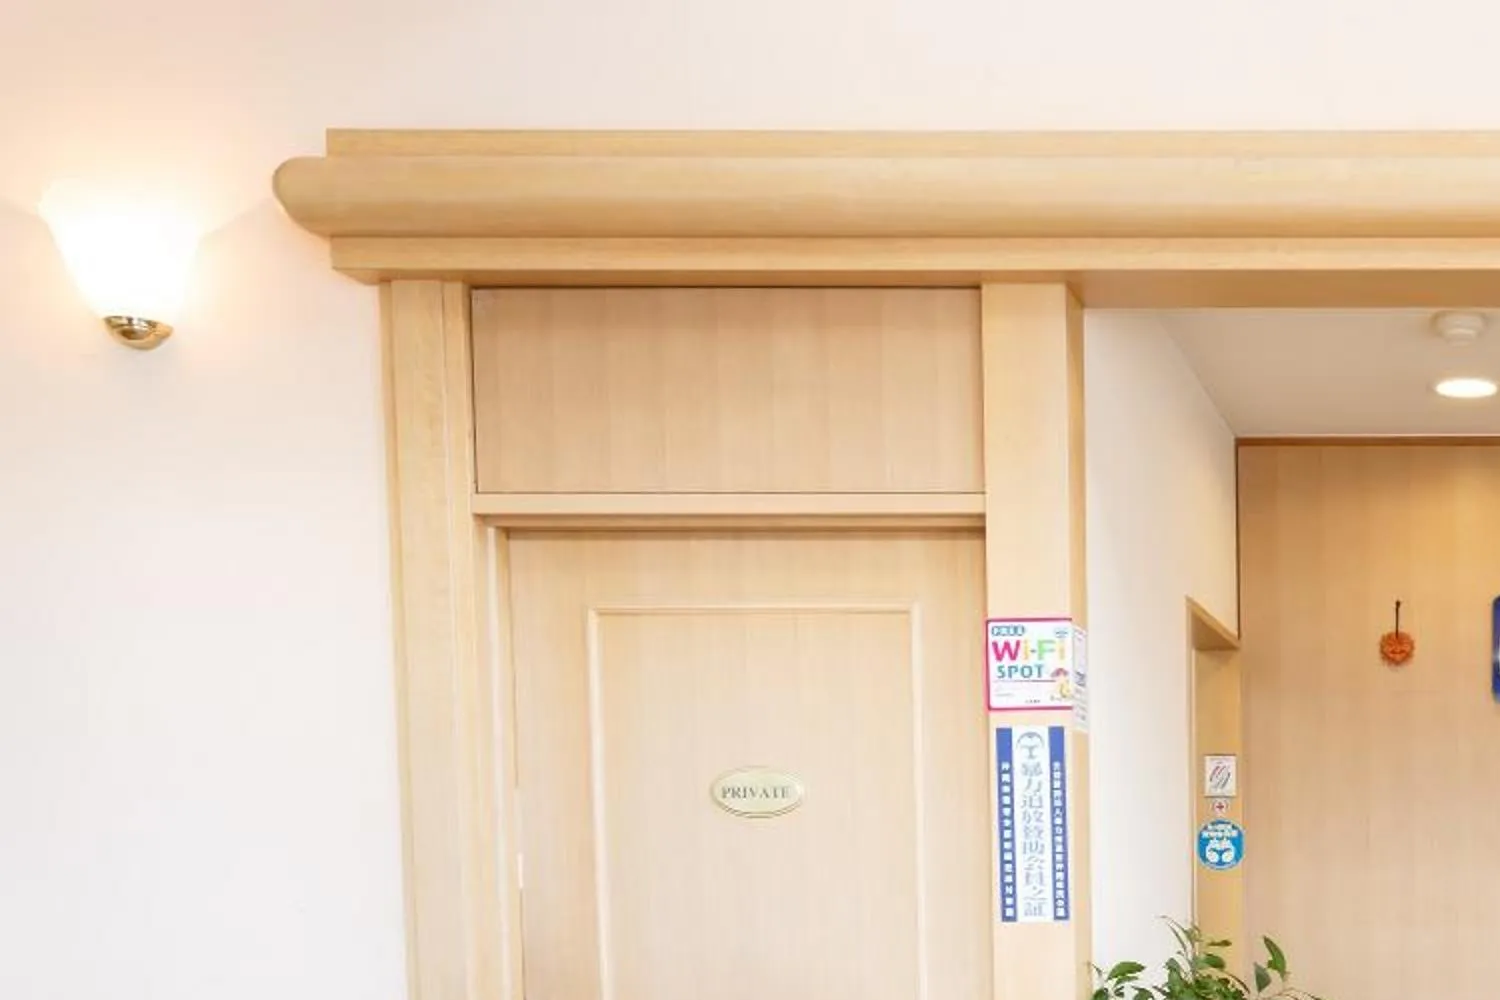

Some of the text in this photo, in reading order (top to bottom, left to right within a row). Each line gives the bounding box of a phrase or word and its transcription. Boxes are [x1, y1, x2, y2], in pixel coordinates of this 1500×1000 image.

[991, 638, 1065, 662] Wi-Fi
[997, 664, 1044, 679] SPOT
[721, 785, 789, 799] PRIVATE
